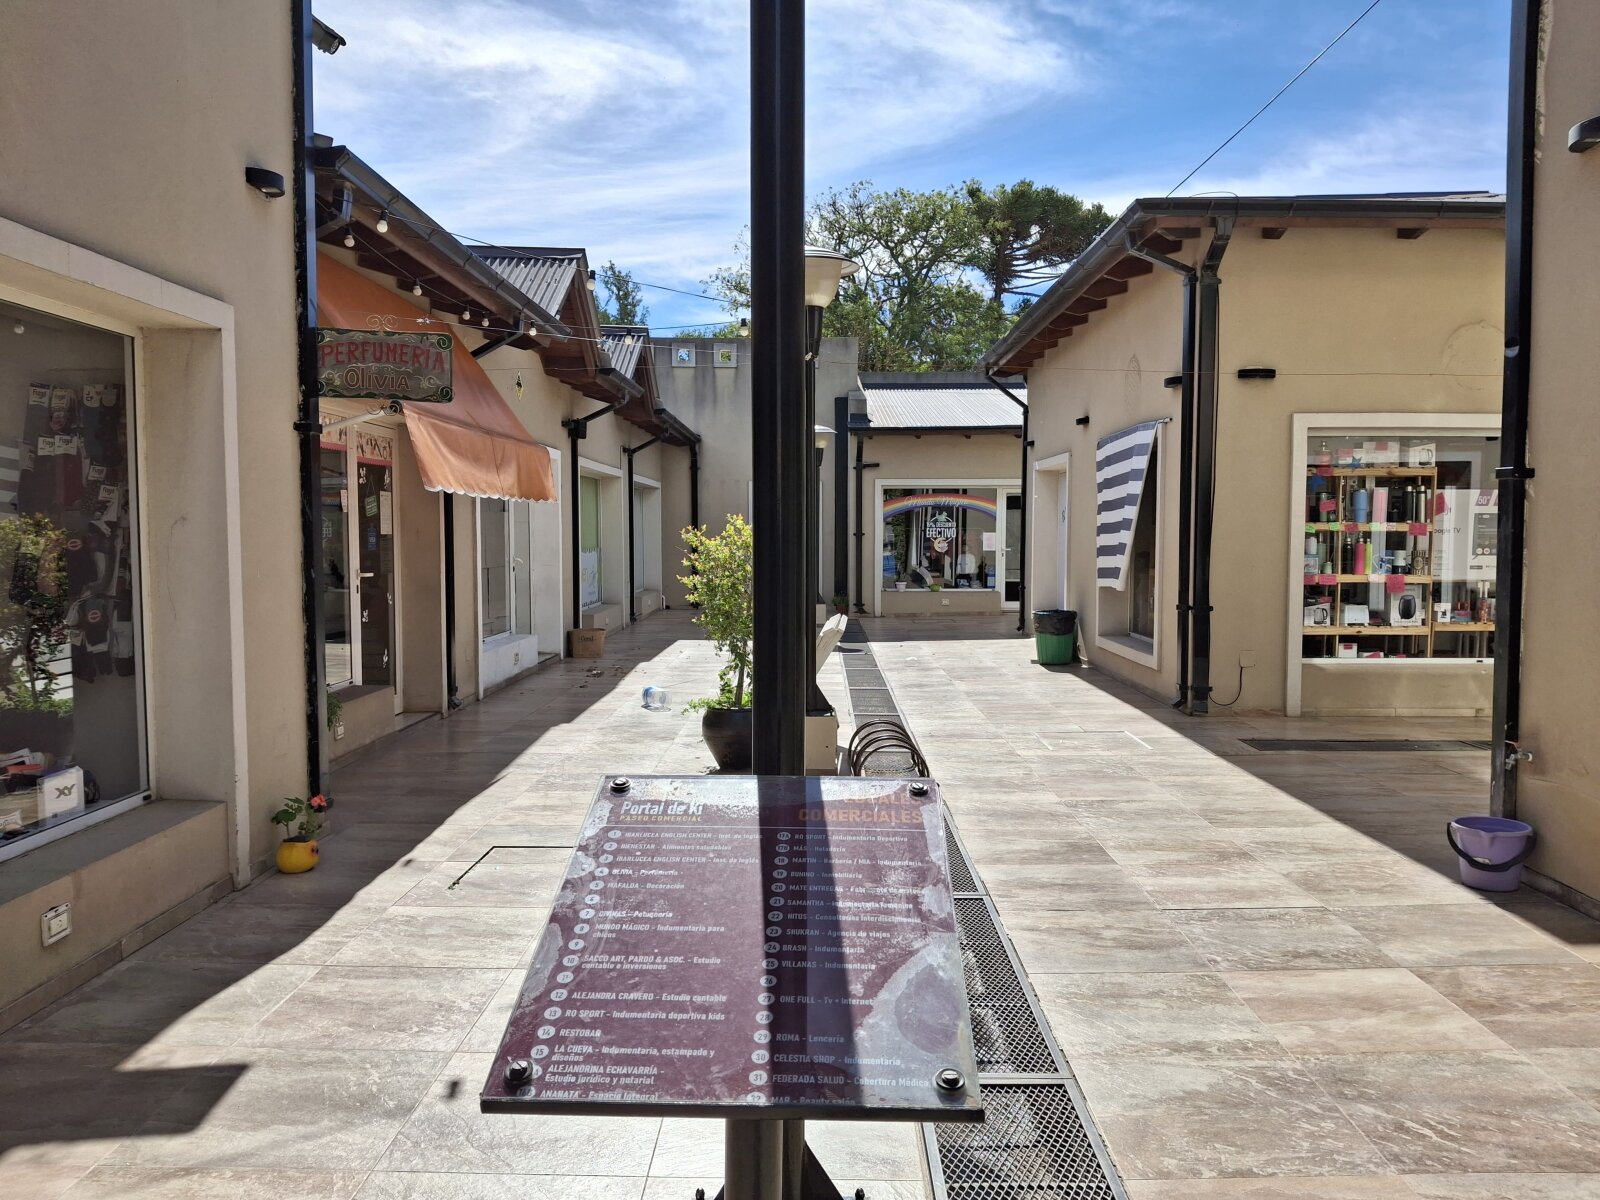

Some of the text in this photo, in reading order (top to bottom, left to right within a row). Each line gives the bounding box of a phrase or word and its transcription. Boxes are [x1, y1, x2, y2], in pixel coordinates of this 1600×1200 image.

[926, 527, 957, 538] EFECTIVO
[620, 801, 665, 815] Portal
[667, 802, 687, 815] de
[799, 808, 922, 824] COMERCIALES
[595, 923, 621, 931] MUNDO
[621, 922, 650, 931] MÁGICO
[657, 924, 706, 932] Indumentaria
[868, 931, 891, 939] viajes
[767, 943, 777, 951] 24
[584, 955, 609, 963] SACCO
[663, 956, 686, 964] ASOC.
[693, 957, 721, 965] Estudio
[766, 960, 877, 970] 25 VILLANAS Indumentaria
[764, 977, 773, 985] 26
[554, 991, 728, 1002] 12 ALEJANDRA CRAVERO Estudio contable
[779, 995, 796, 1004] ONE
[796, 995, 816, 1004] FULL
[841, 997, 874, 1005] Internet
[549, 1009, 726, 1021] 13 RO SPORT Indumentaria deportiva kids
[541, 1028, 602, 1037] 14 RESTOBAR
[776, 1033, 801, 1042] ROMA
[808, 1033, 845, 1043] Lencería
[535, 1044, 716, 1058] 15 LA CUEVA Indumentaria, estampado y
[551, 1053, 584, 1062] diseños
[773, 1053, 811, 1063] CELESTIA
[813, 1055, 836, 1064] SHOP
[844, 1055, 901, 1066] Indumentaria
[547, 1064, 604, 1074] ALEJANDRINA
[605, 1064, 658, 1075] ECHAVARRÍA
[545, 1073, 655, 1086] Estudio jurídico y notarial
[753, 1073, 929, 1087] 31 FEDERADA SALUD Cobertura Médica
[539, 1090, 580, 1099] ANAHATA
[588, 1091, 622, 1100] Espacio
[623, 1091, 659, 1101] Integral
[771, 1096, 791, 1104] MAR
